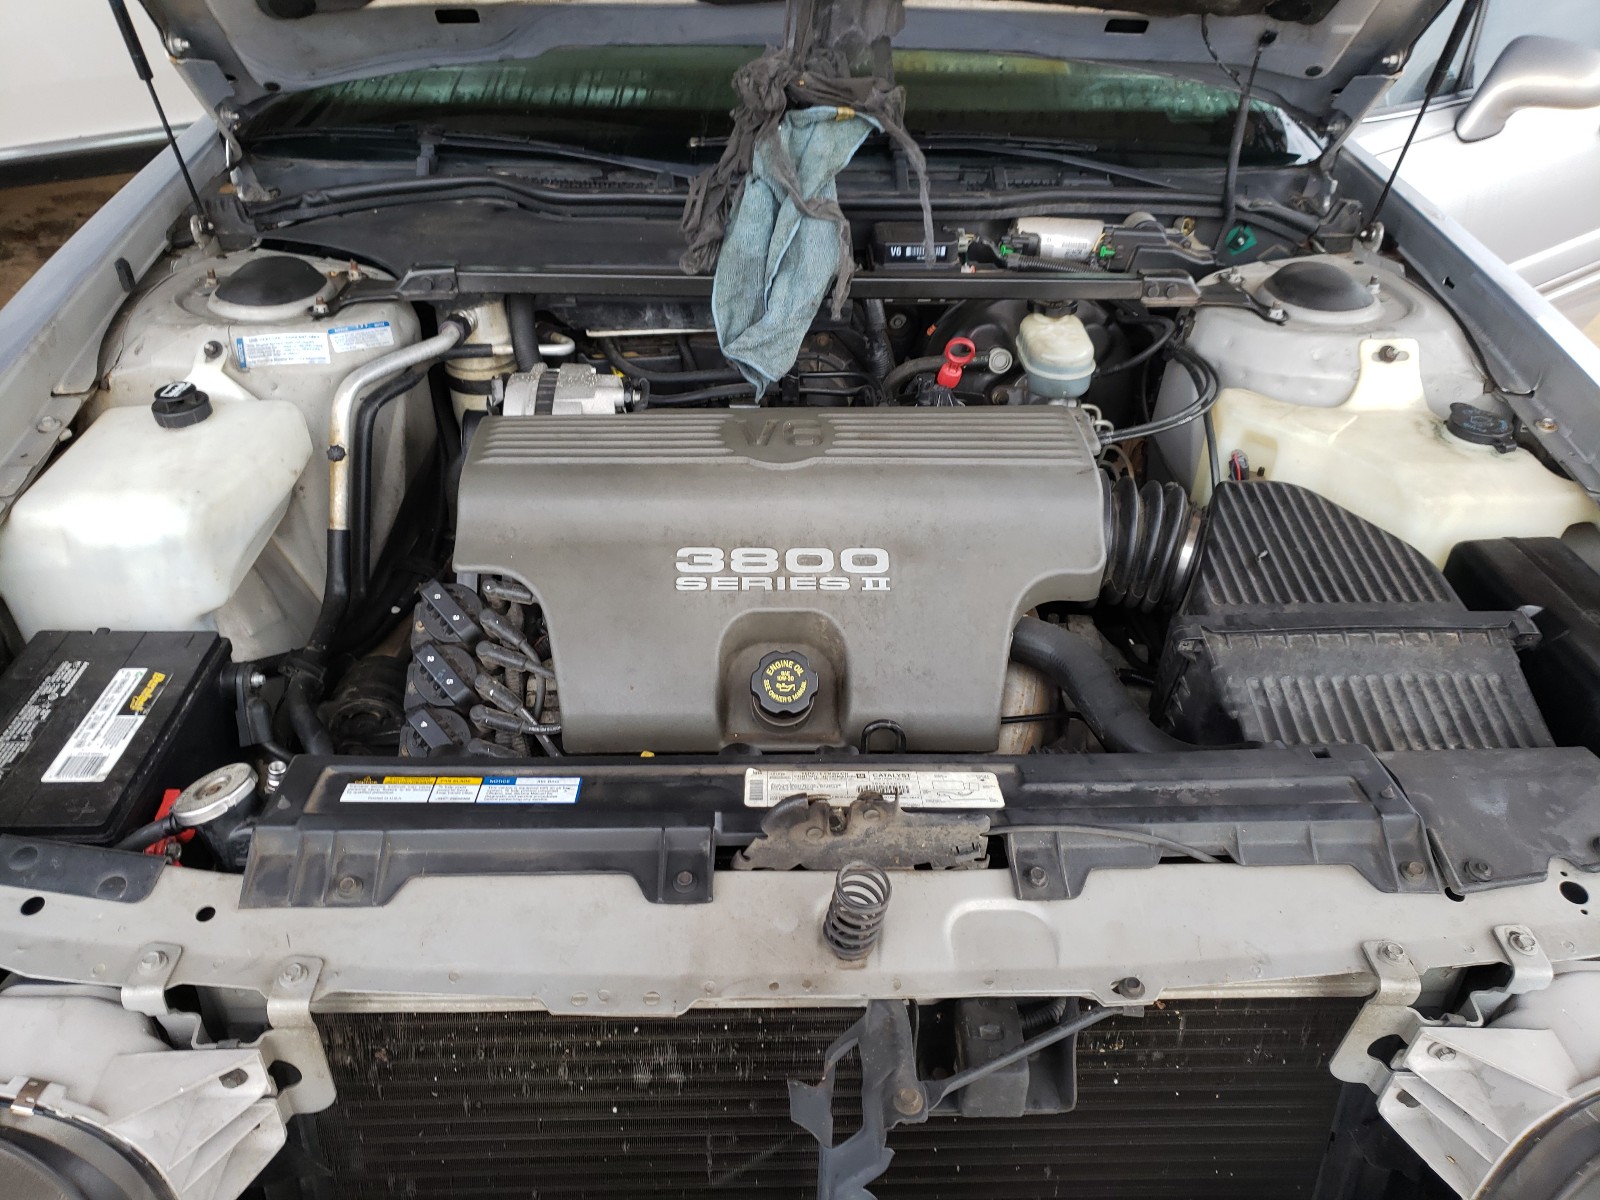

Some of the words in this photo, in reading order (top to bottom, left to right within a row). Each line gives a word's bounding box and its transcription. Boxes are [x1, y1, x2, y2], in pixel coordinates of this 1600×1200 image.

[734, 419, 823, 446] V6
[675, 547, 890, 573] 3800
[675, 576, 850, 591] SERIES
[861, 577, 890, 591] II
[766, 660, 794, 676] ENGINE
[794, 664, 804, 677] OIL
